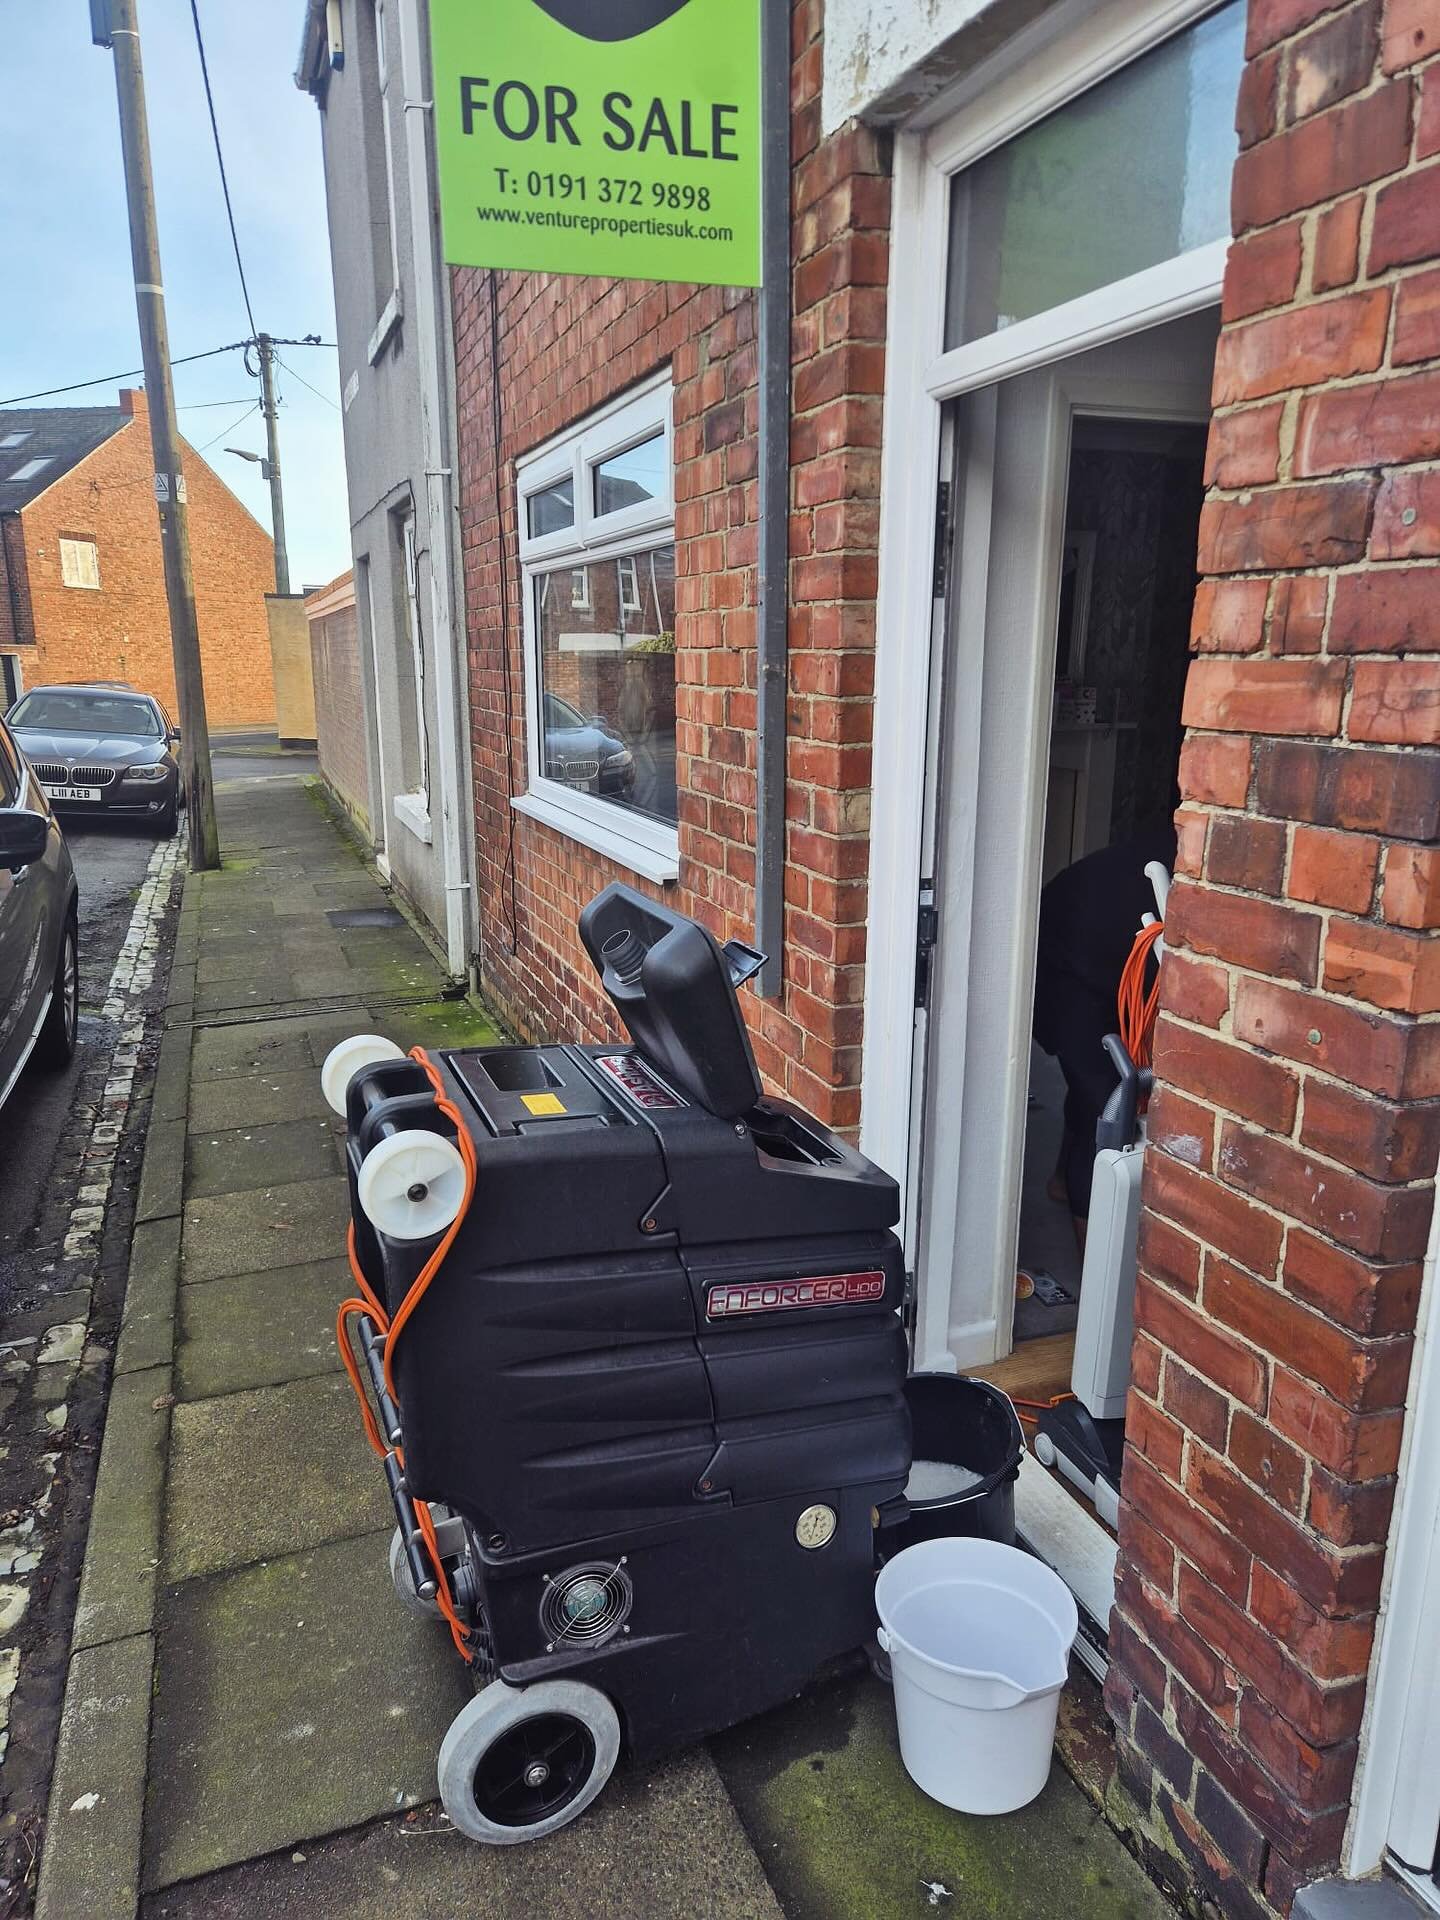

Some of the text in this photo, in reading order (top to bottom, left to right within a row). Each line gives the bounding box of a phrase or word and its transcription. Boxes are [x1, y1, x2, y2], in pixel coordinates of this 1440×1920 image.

[459, 75, 739, 162] FOR SALE
[493, 167, 711, 212] T: 0191 372 9898
[476, 206, 733, 241] www.venturepropertiesuk.com
[70, 788, 90, 799] AEB
[847, 1281, 881, 1294] 400
